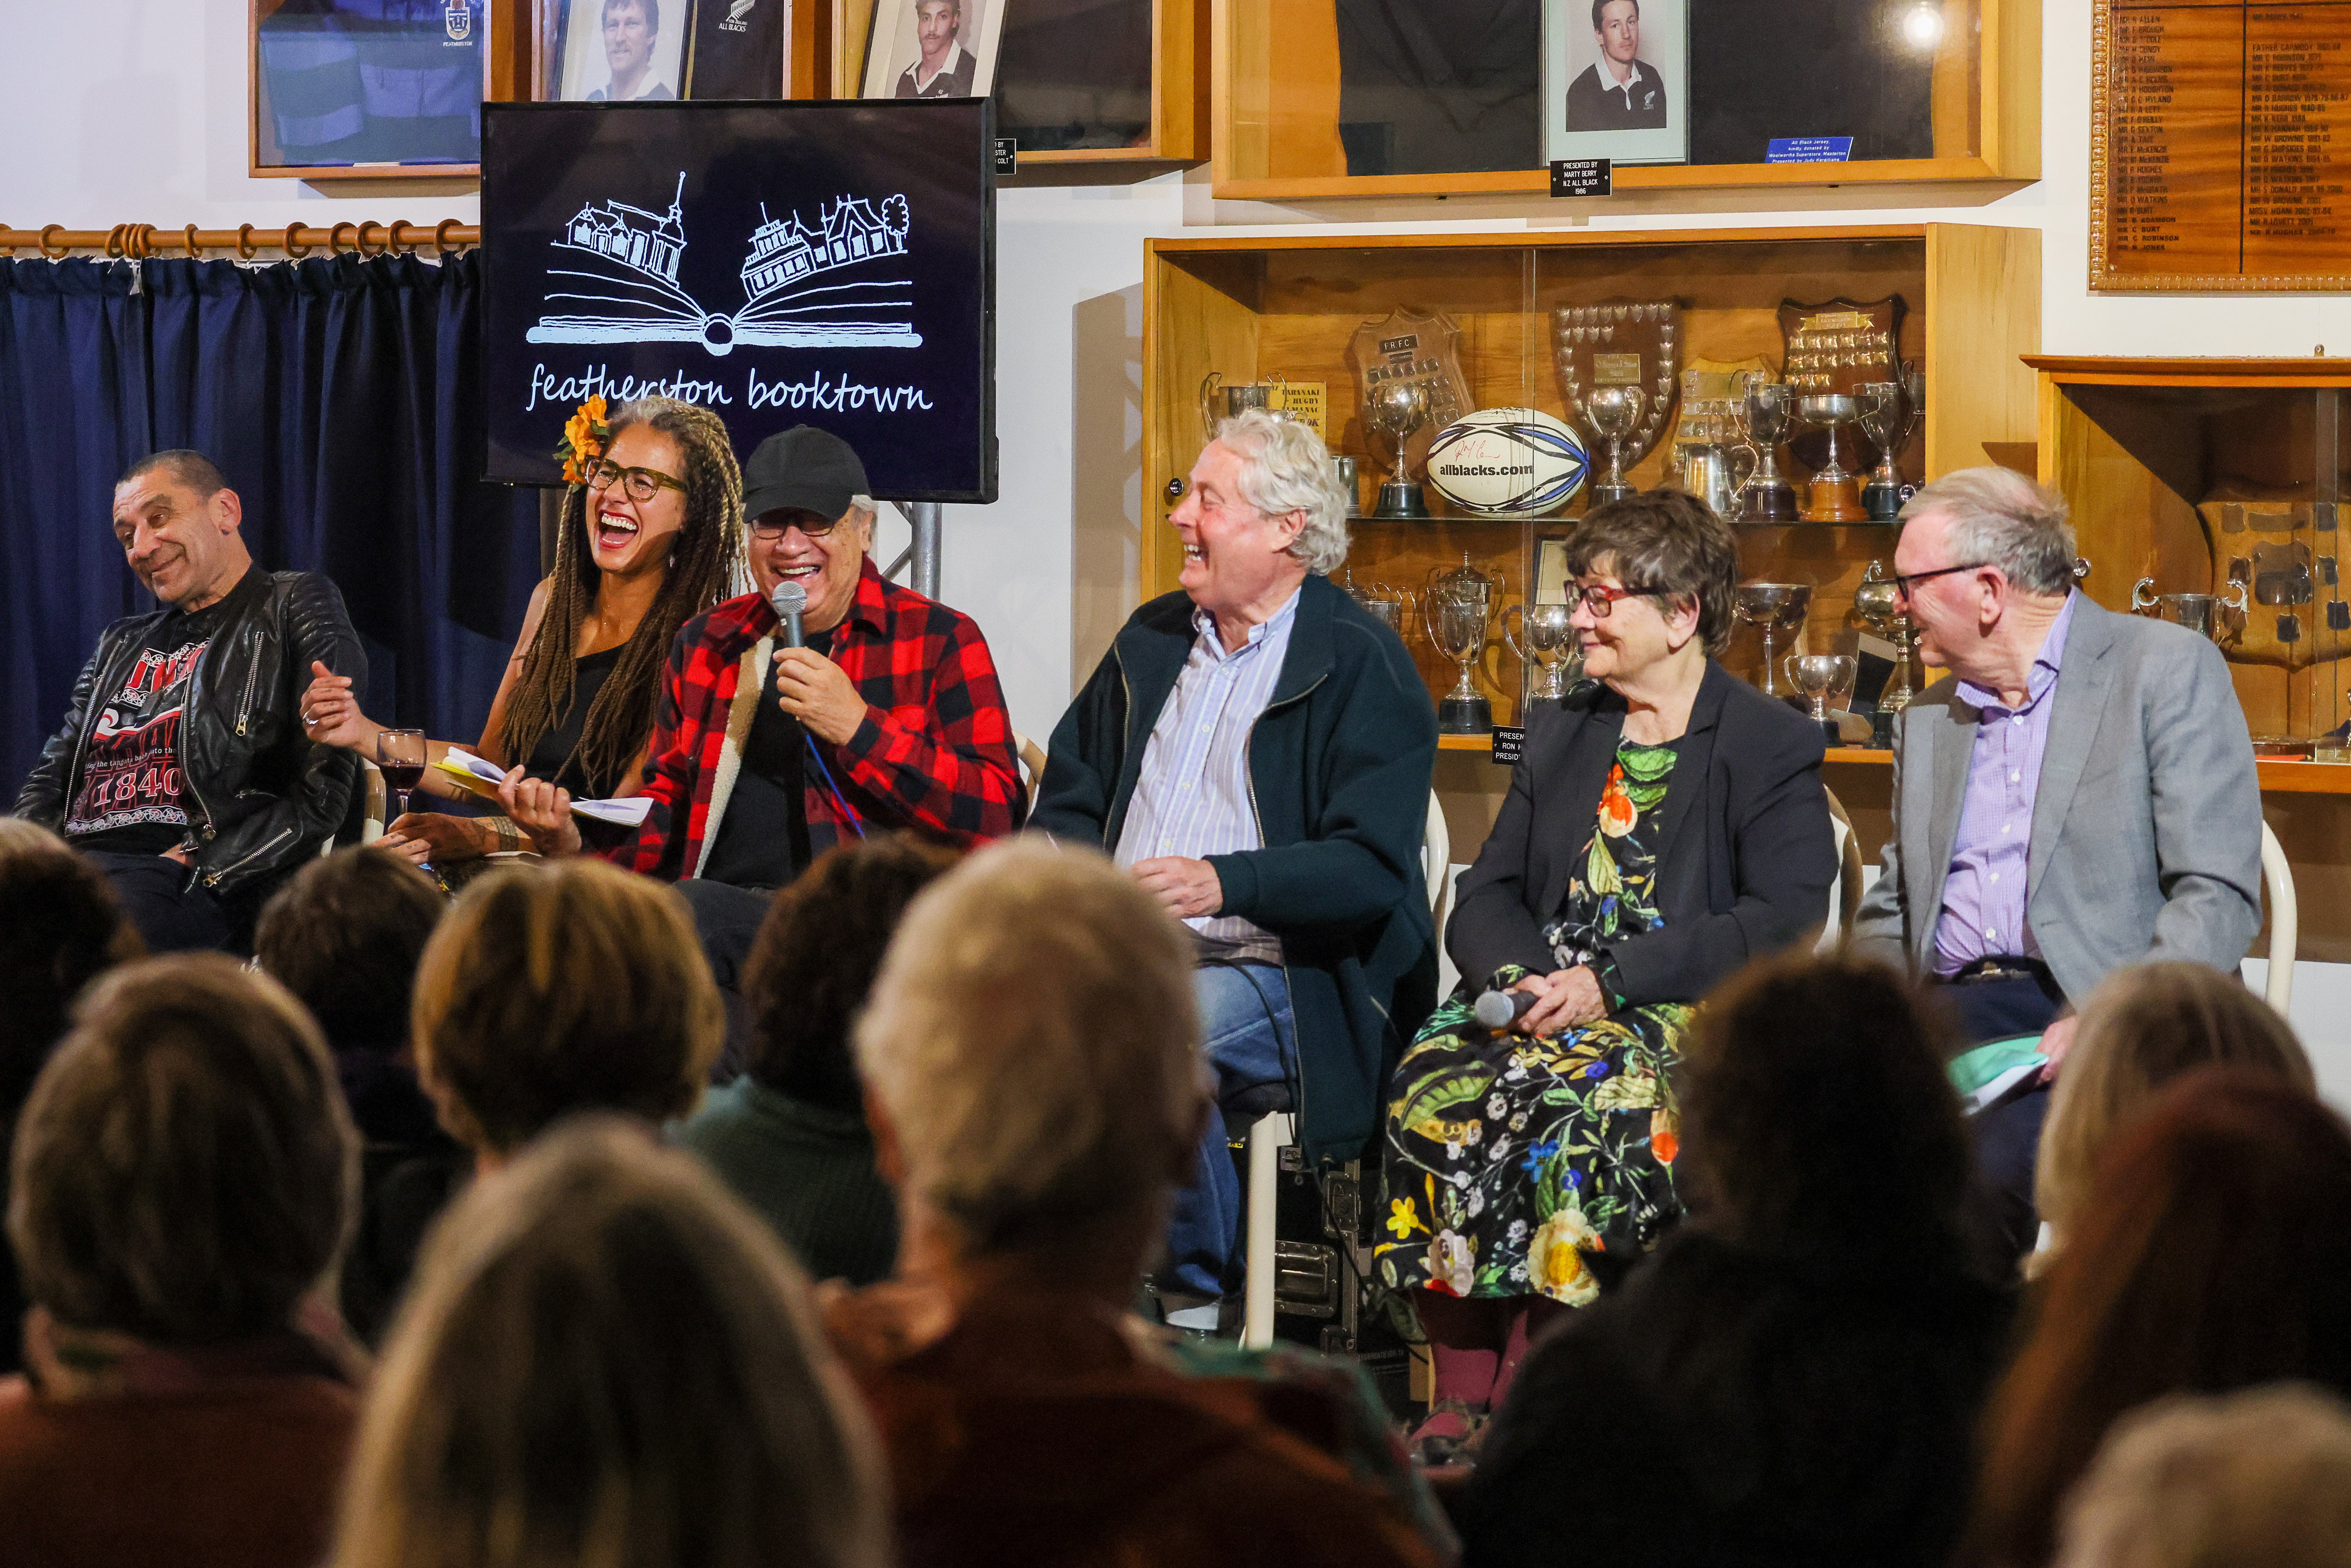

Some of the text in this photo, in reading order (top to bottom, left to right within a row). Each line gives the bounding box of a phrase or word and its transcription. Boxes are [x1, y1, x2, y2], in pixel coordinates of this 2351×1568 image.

[728, 24, 746, 32] BLACKS
[525, 363, 933, 412] featherston booktown
[1440, 464, 1533, 476] allblacks.com
[110, 758, 133, 767] tangata
[94, 768, 185, 807] 1840
